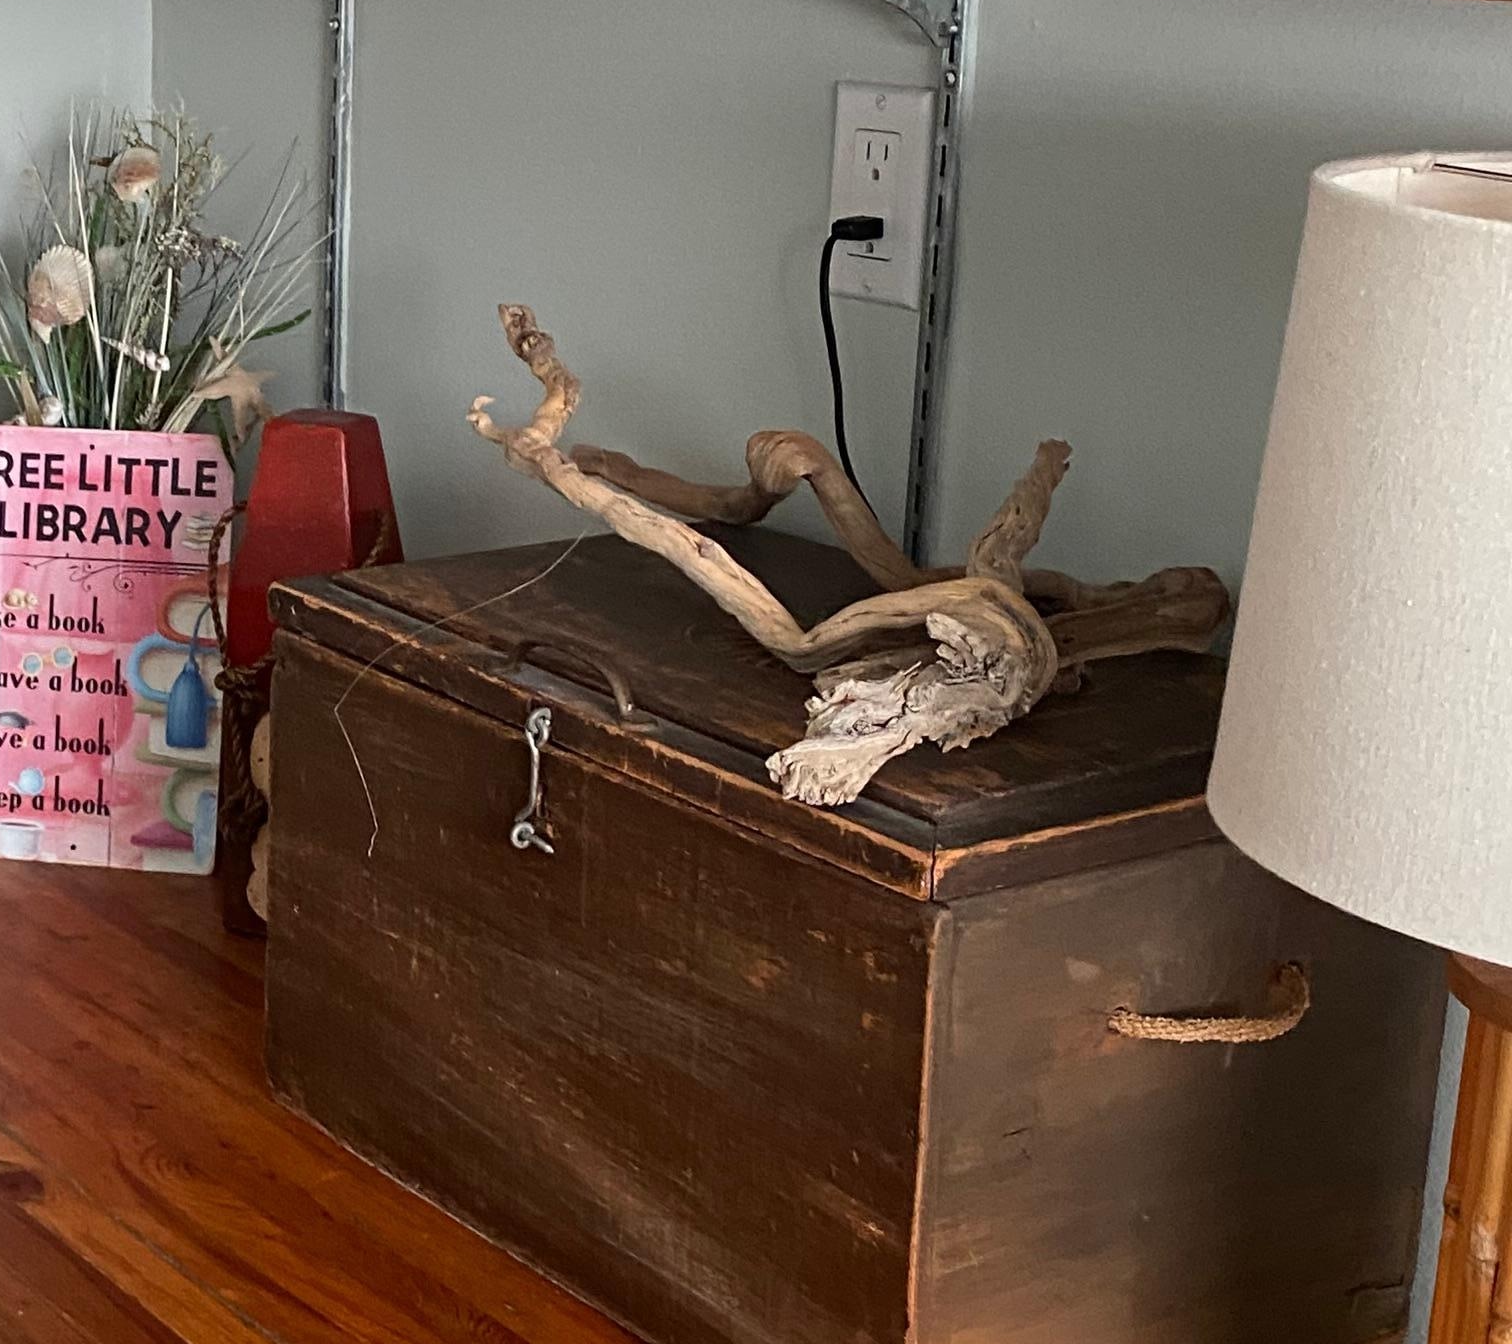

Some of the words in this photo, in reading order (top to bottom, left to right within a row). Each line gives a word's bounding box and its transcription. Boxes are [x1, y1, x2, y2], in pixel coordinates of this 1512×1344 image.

[80, 455, 217, 496] LITTLE
[26, 612, 39, 628] a
[48, 594, 104, 633] book
[49, 673, 62, 691] a
[71, 658, 128, 696] book
[33, 734, 46, 750] a
[54, 715, 111, 755] book
[32, 792, 45, 811] a
[53, 776, 110, 817] book
